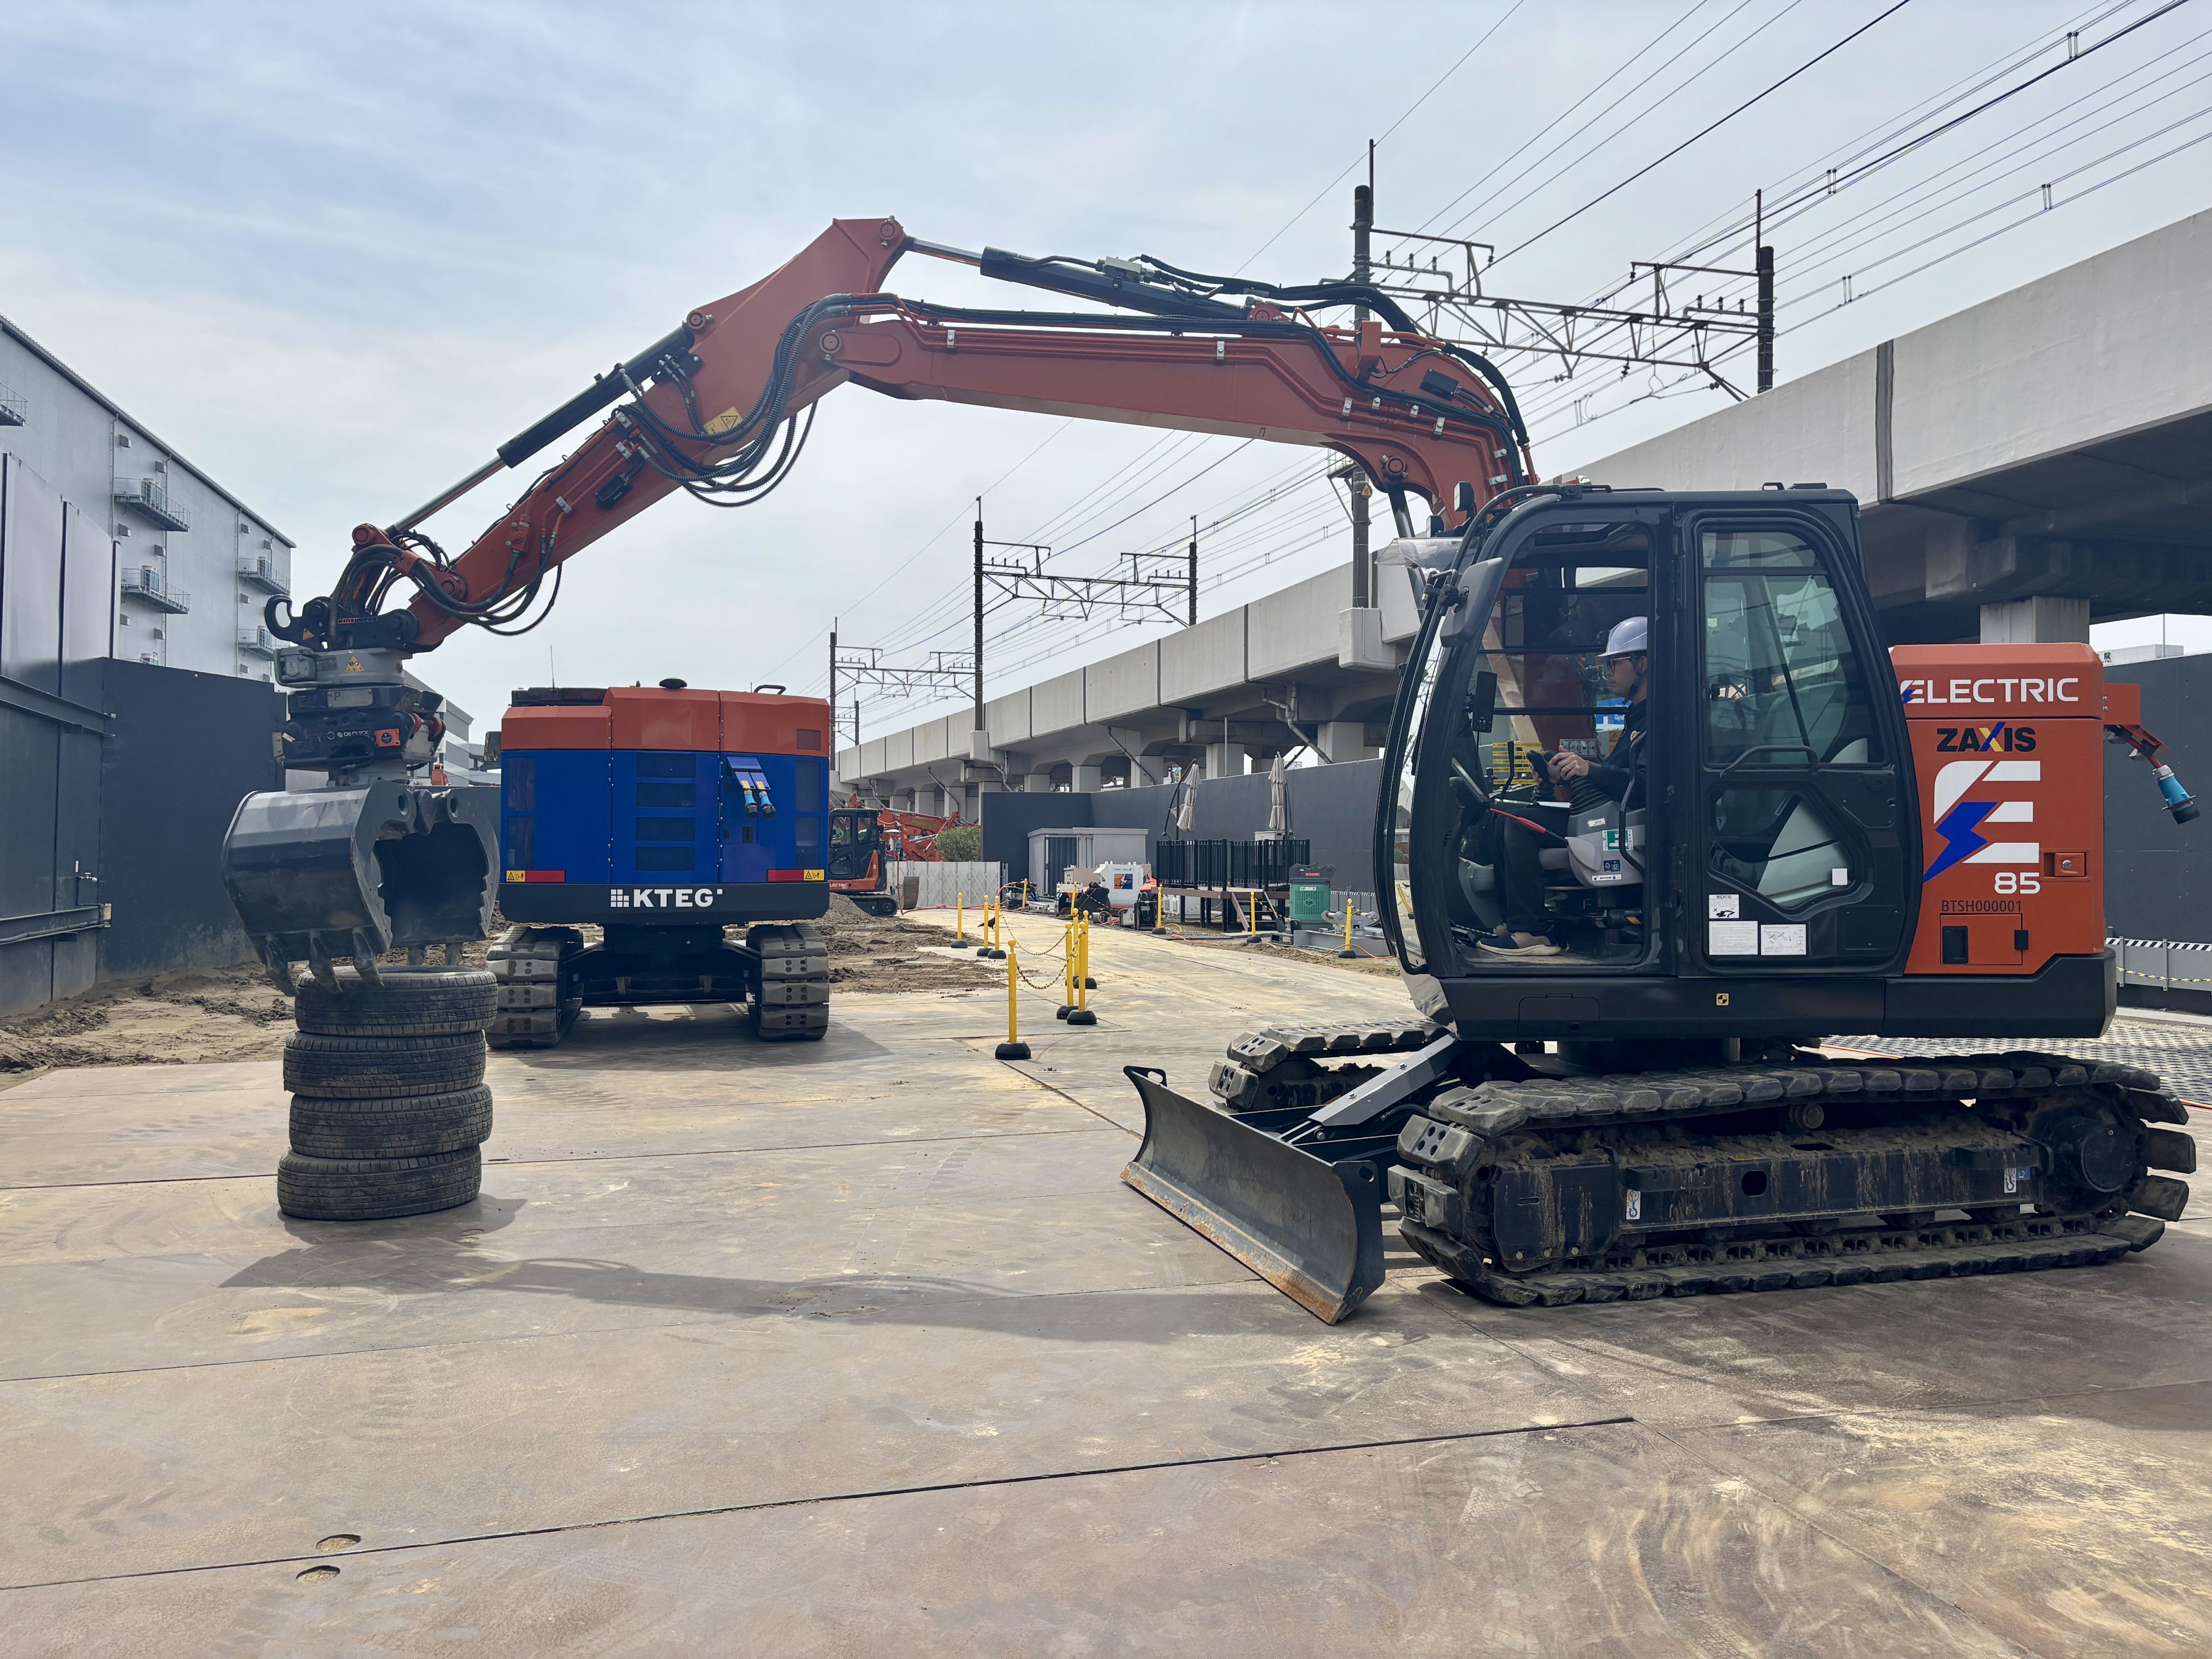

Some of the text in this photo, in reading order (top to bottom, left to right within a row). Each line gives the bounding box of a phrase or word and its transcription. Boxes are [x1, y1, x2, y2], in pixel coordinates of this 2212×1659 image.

[1900, 678, 2079, 704] ELECTRIC
[1937, 722, 2036, 752] ZAXIS
[1994, 872, 2041, 894] 85
[634, 888, 713, 907] KTEG
[1941, 900, 2021, 912] BTSH000001
